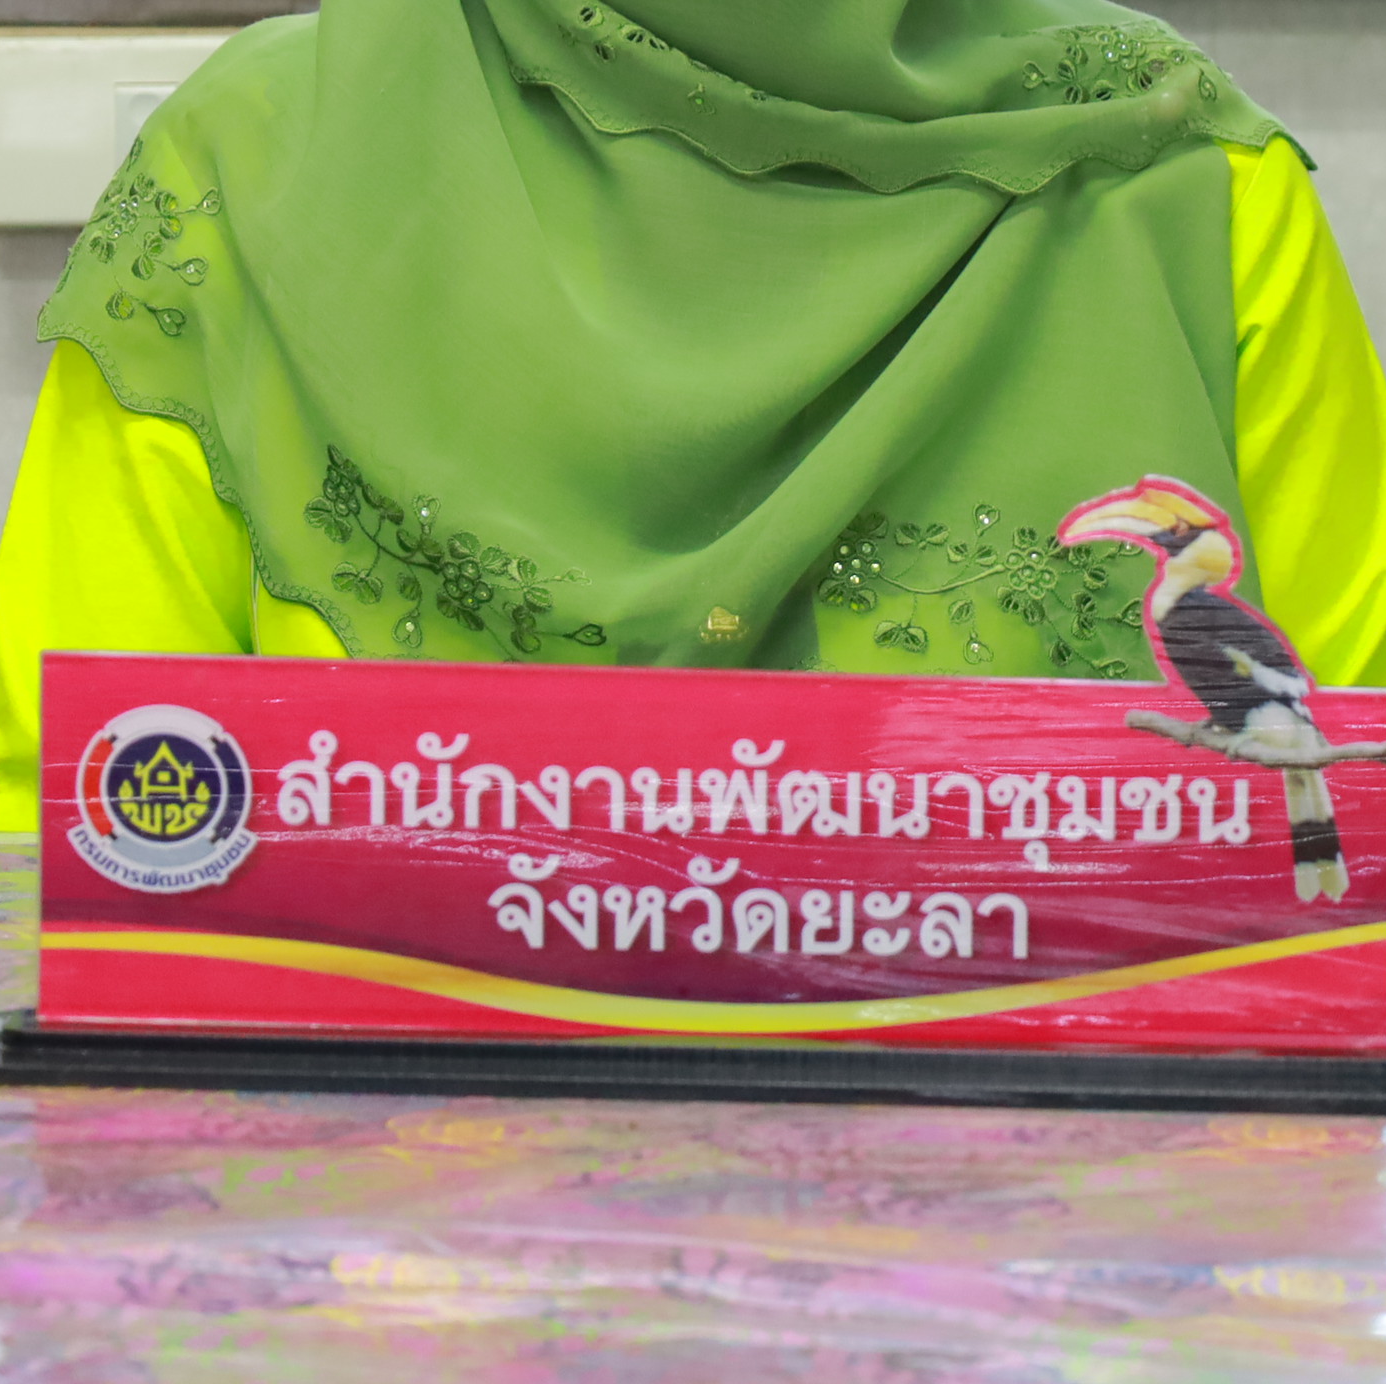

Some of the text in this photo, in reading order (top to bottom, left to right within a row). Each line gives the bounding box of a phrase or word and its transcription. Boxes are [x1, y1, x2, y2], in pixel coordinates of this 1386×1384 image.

[277, 730, 1252, 872] สำนักงานพัฒนาชุมชน
[487, 853, 1028, 959] จังหวัดยะลา
